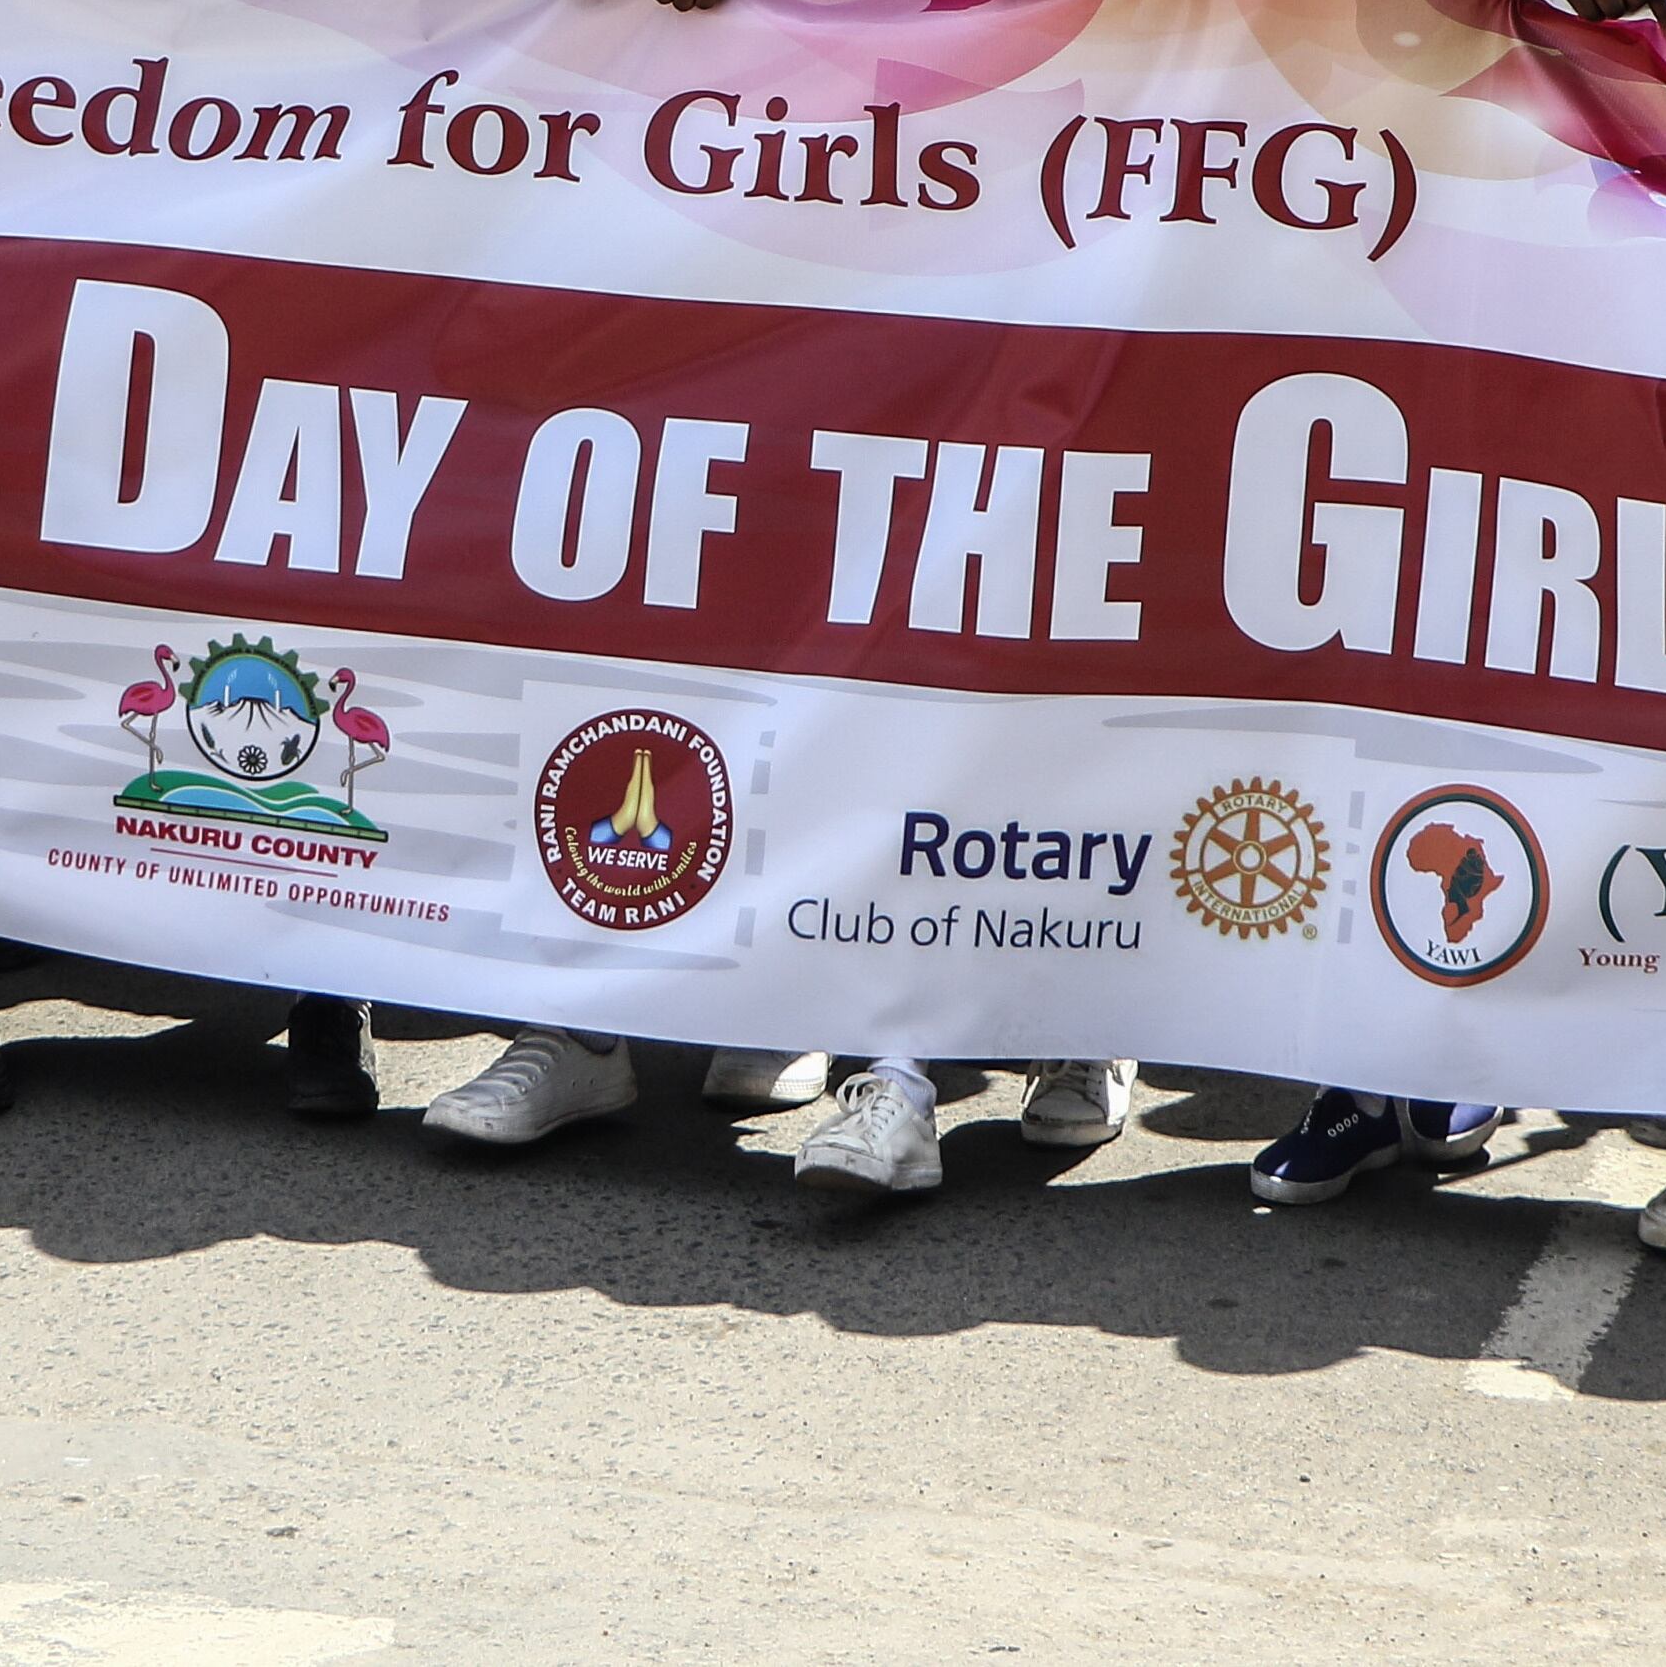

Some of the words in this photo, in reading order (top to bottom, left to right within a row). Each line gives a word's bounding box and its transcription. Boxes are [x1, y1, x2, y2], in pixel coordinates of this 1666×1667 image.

[386, 69, 603, 183] for
[643, 88, 982, 212] Girls
[1039, 112, 1419, 263] (FFG)
[39, 278, 470, 581] DAY
[510, 406, 753, 611] OF
[810, 428, 1153, 643] THE
[541, 714, 687, 800] RAMCHANDANI
[687, 733, 728, 882] FOUNDATION
[1220, 793, 1289, 814] ROTARY
[115, 815, 242, 851] NAKURU
[250, 833, 379, 870] COUNTY
[539, 803, 563, 864] RANI
[587, 845, 615, 866] WE
[618, 849, 669, 872] SERVE
[670, 840, 698, 880] smiles
[899, 809, 1153, 896] Rotary
[47, 848, 126, 876] COUNTY
[135, 862, 160, 880] OF
[168, 865, 279, 898] UNLIMITED
[288, 884, 451, 922] OPPORTUNITIES
[559, 876, 617, 923] TEAM
[624, 890, 686, 924] RANI
[1191, 879, 1305, 923] INTERNATIONAL
[786, 897, 894, 946] Club
[910, 906, 960, 946] of
[974, 908, 1142, 951] Nakuru
[1426, 939, 1483, 966] YAWI
[1578, 947, 1660, 974] Young
